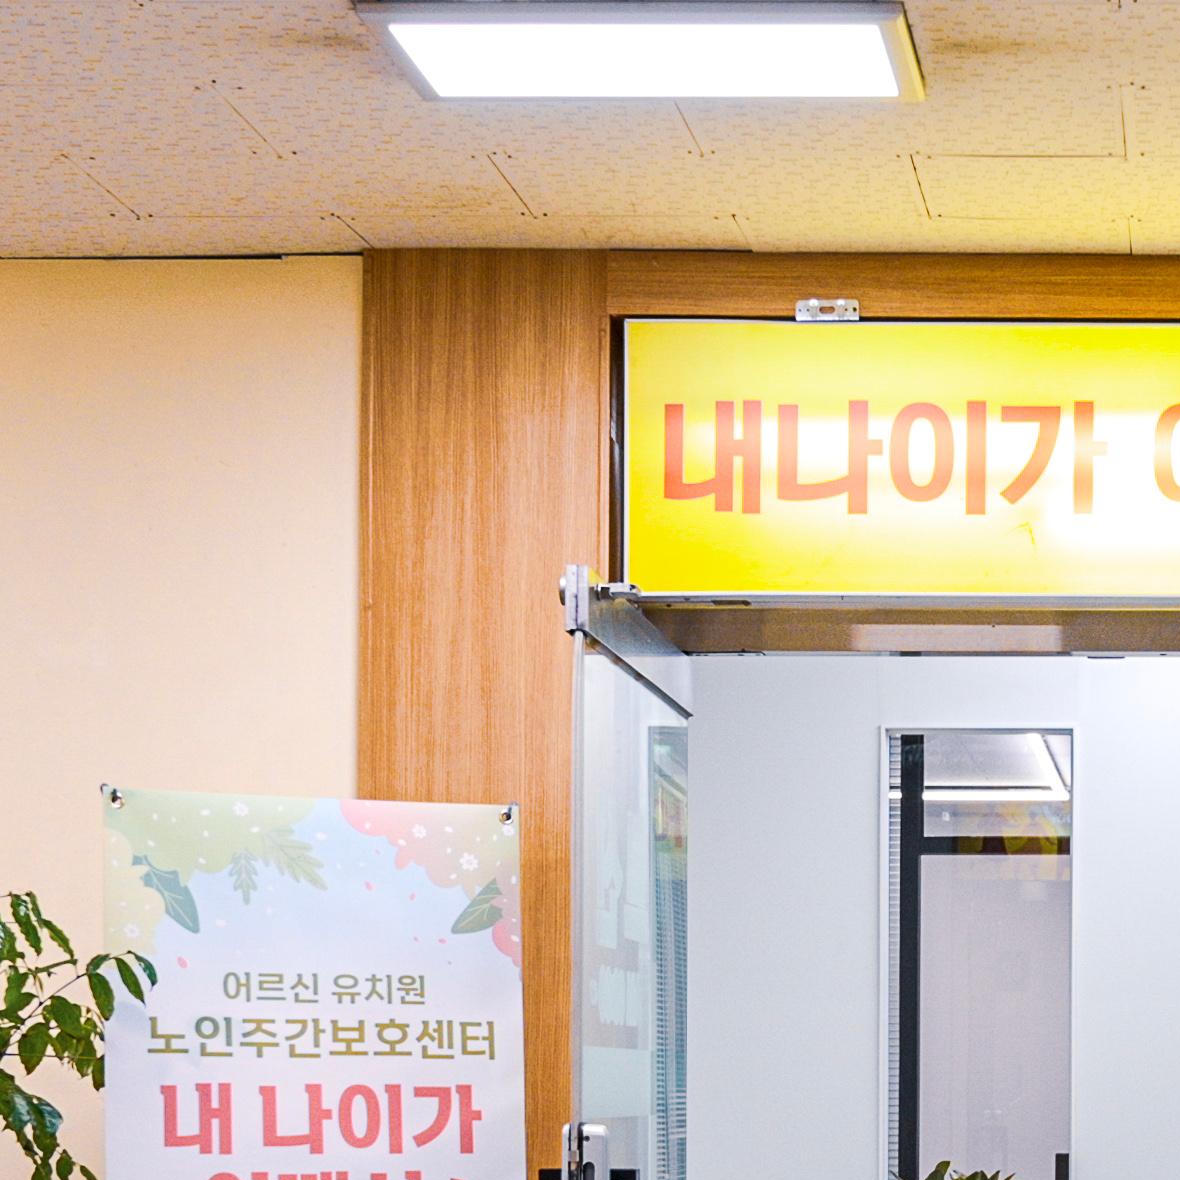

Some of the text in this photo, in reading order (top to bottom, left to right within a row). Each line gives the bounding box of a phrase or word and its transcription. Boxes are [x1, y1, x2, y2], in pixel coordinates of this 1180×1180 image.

[222, 971, 426, 1006] 어르신 유치원
[146, 1015, 496, 1061] 노인주간보호센터
[159, 1082, 483, 1156] 내 나이가
